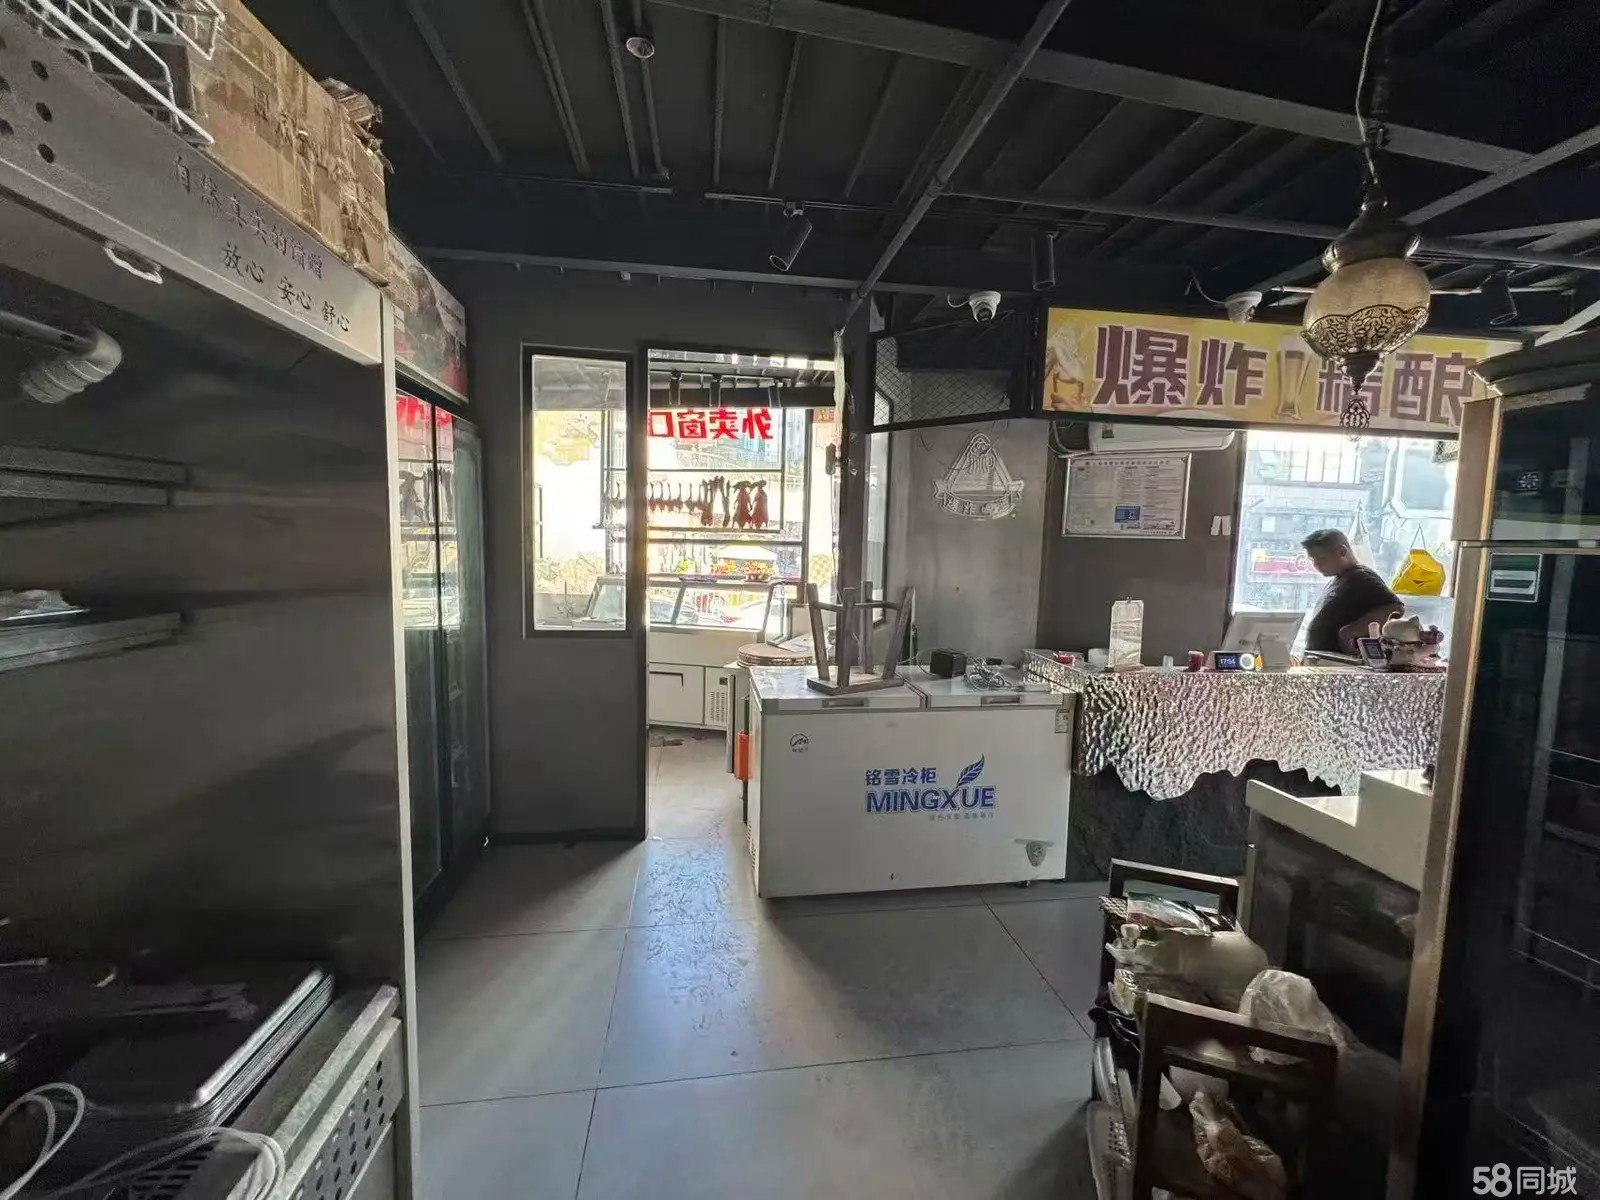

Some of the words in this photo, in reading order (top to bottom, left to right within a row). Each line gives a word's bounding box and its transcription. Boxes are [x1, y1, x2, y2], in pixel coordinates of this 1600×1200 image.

[222, 241, 265, 283] 放心
[278, 275, 312, 310] 安心
[321, 300, 350, 332] 舒心
[1093, 324, 1269, 408] 爆炸
[865, 767, 937, 786] 铭雪冷柜
[866, 786, 996, 813] MINGXUE
